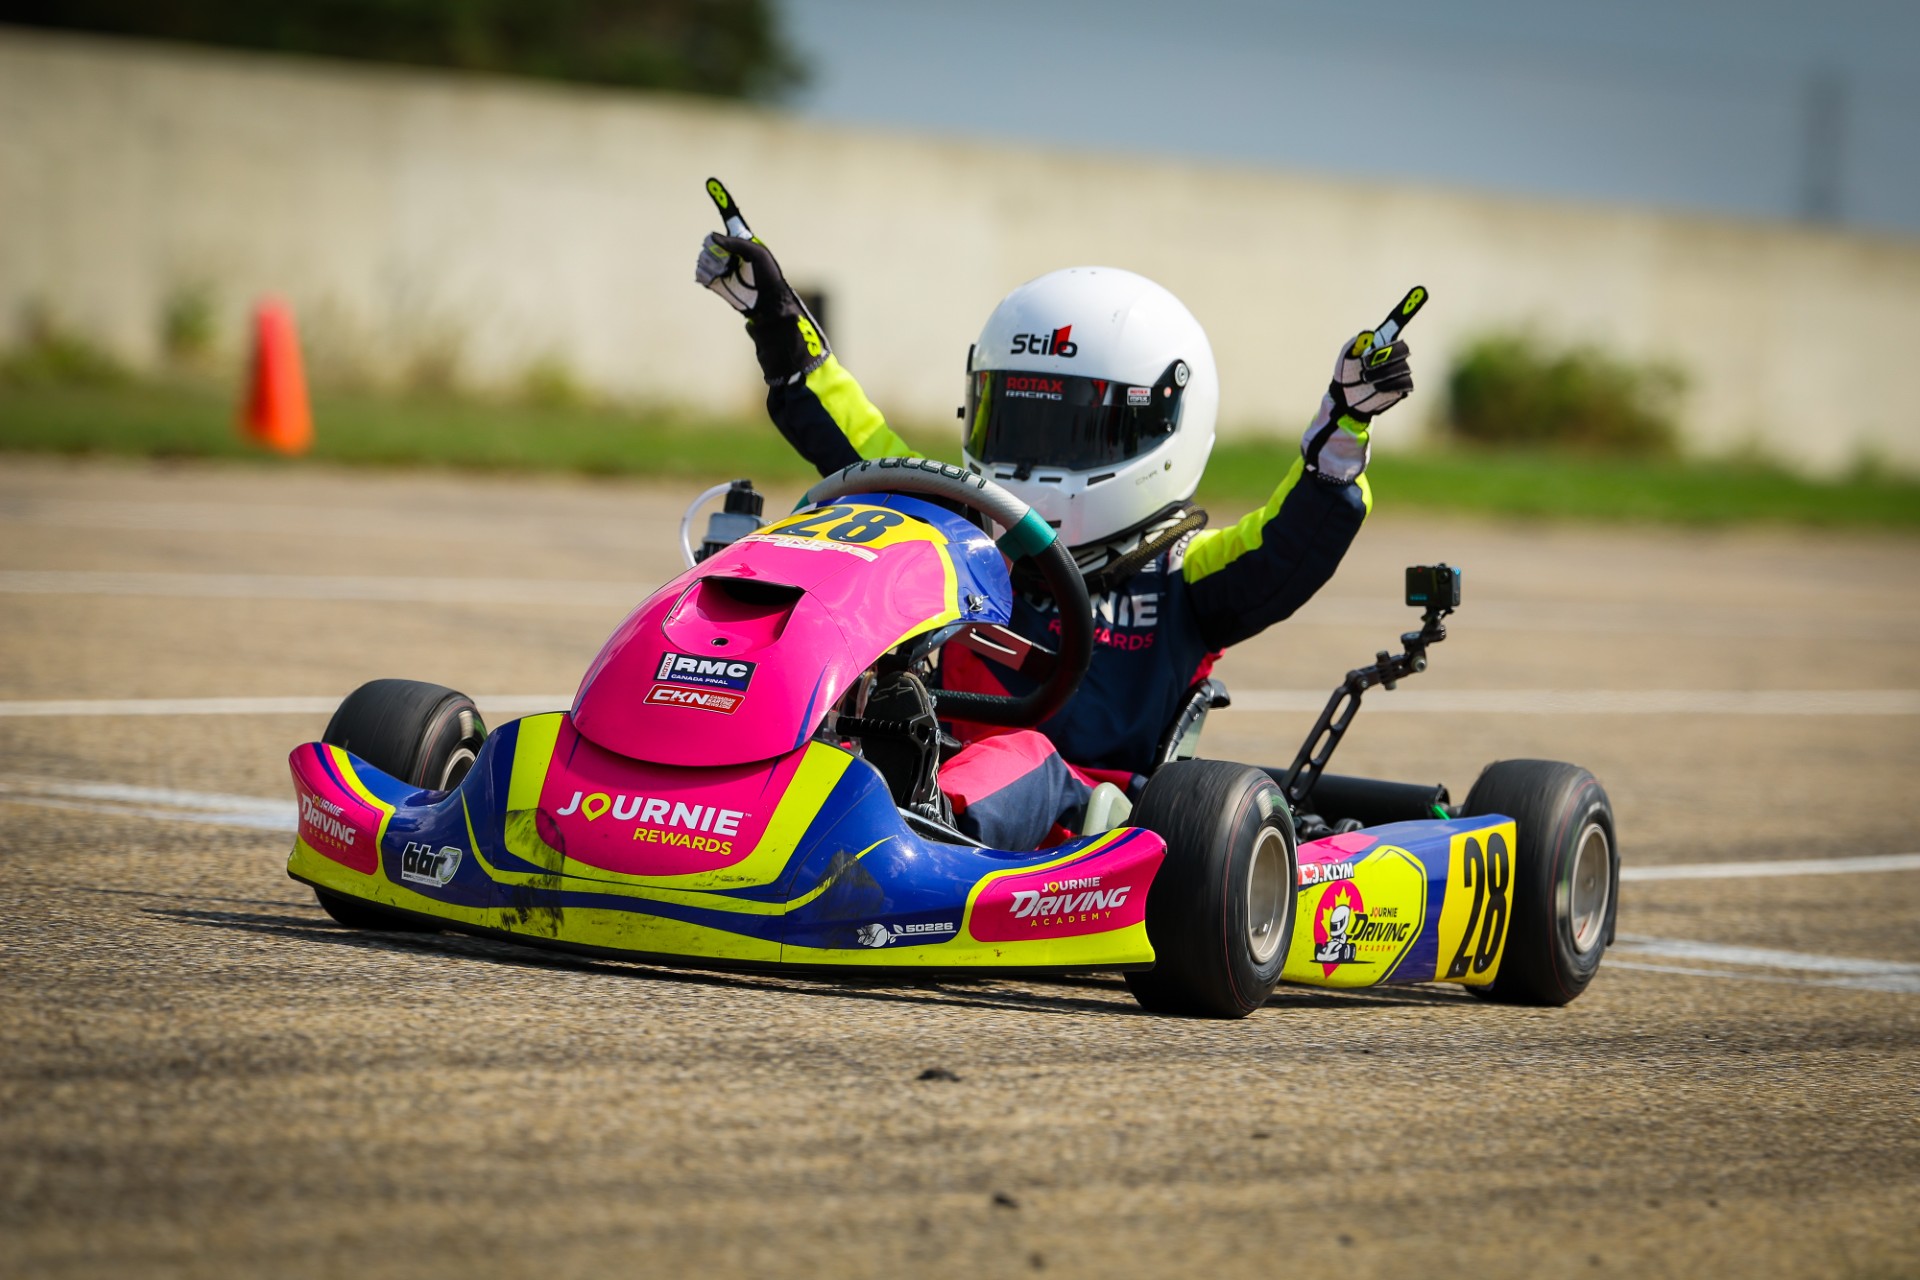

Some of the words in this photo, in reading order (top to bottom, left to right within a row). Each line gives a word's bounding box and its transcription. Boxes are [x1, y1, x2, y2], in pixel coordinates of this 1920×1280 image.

[1010, 327, 1078, 358] Stilo
[1006, 376, 1063, 391] ROTAX
[1005, 390, 1062, 401] RACING
[770, 506, 905, 543] 28
[660, 656, 673, 677] ROTAX
[674, 656, 748, 678] RMC
[671, 673, 704, 682] CANADA
[704, 677, 728, 685] FINAL
[652, 689, 711, 705] CKN
[312, 793, 345, 817] JOURNIE
[301, 793, 357, 846] DRIVING
[309, 828, 348, 853] ACADEMY
[632, 827, 733, 856] REWARDS
[403, 842, 448, 879] bbr
[1312, 862, 1354, 884] J.KLYM
[1041, 876, 1101, 893] JOURNIE
[1009, 886, 1132, 919] DRIVING
[1370, 907, 1398, 918] JOURNIE
[1444, 832, 1510, 978] 28
[905, 922, 954, 934] 50226
[1030, 911, 1112, 927] ACADEMY
[1348, 913, 1411, 943] DRIVING
[1358, 944, 1397, 952] ACADEMY
